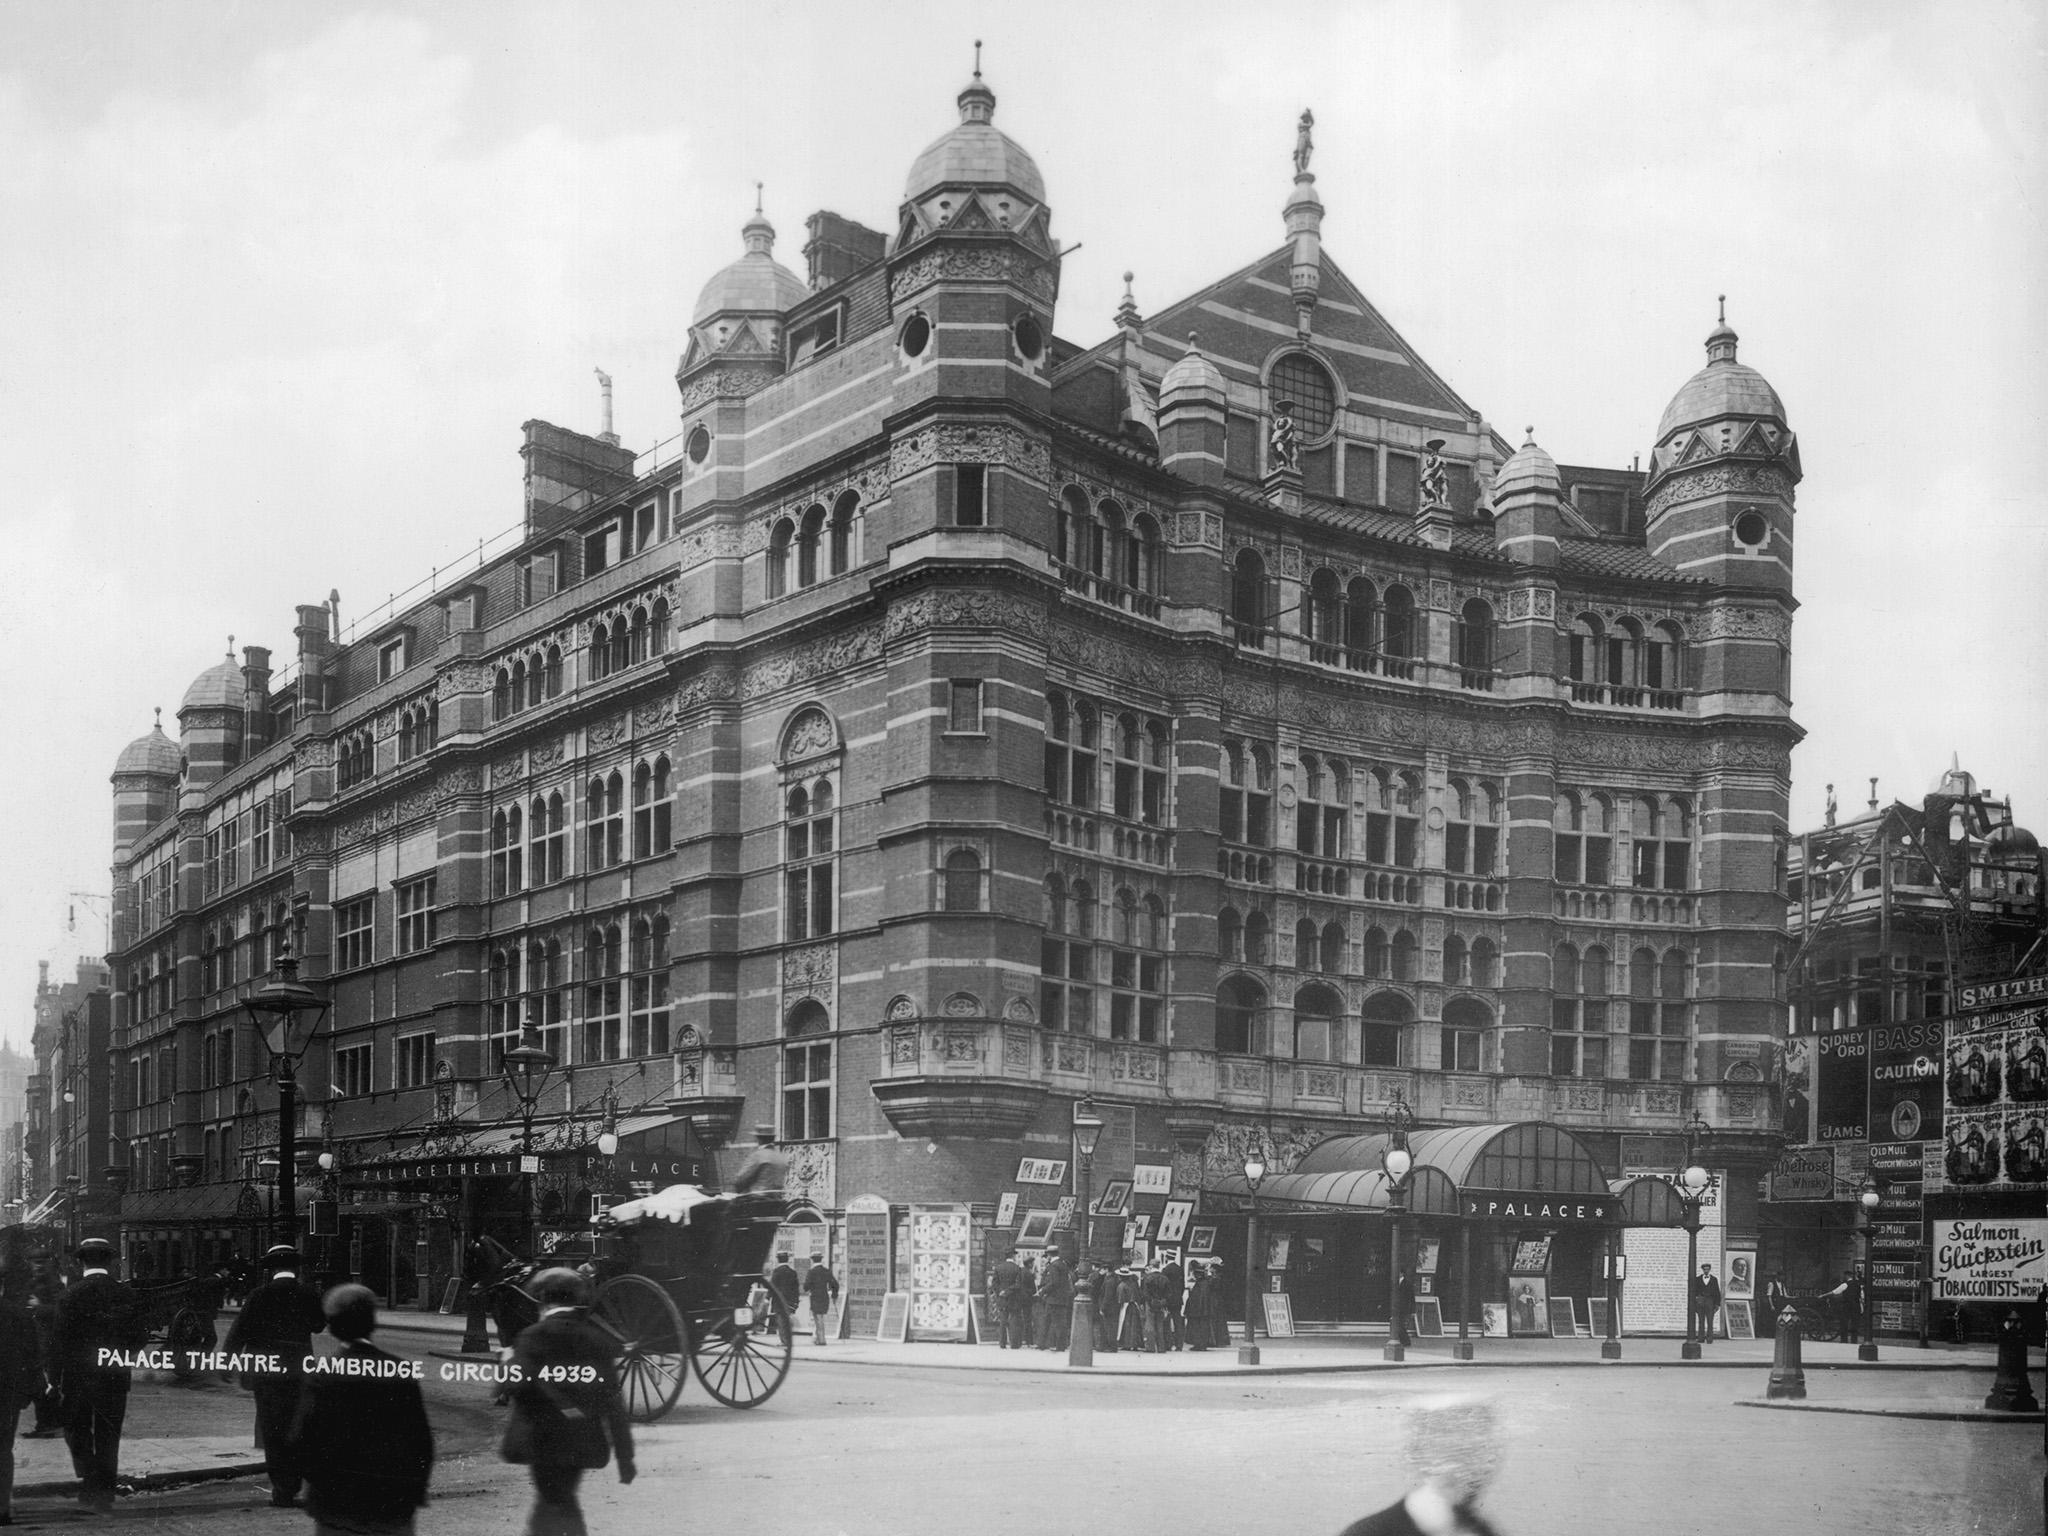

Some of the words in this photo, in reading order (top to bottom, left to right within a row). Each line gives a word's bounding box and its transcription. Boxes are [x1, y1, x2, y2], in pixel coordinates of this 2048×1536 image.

[1820, 1032, 1864, 1054] SIDNEY
[1873, 1023, 1943, 1051] BASS
[1837, 1045, 1865, 1058] ORD
[1874, 1061, 1939, 1080] CAUTION
[1871, 1146, 1887, 1157] OLD
[1888, 1145, 1907, 1156] MULL
[363, 1165, 436, 1182] PALACE
[448, 1159, 545, 1175] THEATE
[1872, 1159, 1895, 1168] SCOTCH
[1896, 1159, 1922, 1168] WHISKY
[1489, 1202, 1585, 1218] PALACE
[1886, 1224, 1906, 1234] MULL
[1948, 1221, 2019, 1241] Salmon
[1939, 1237, 2045, 1273] Gluckstein
[1886, 1263, 1905, 1274] MULL
[1970, 1269, 2013, 1278] LARGEST
[1894, 1278, 1921, 1288] WHISKY
[1937, 1277, 2019, 1298] TOBACCONISTS
